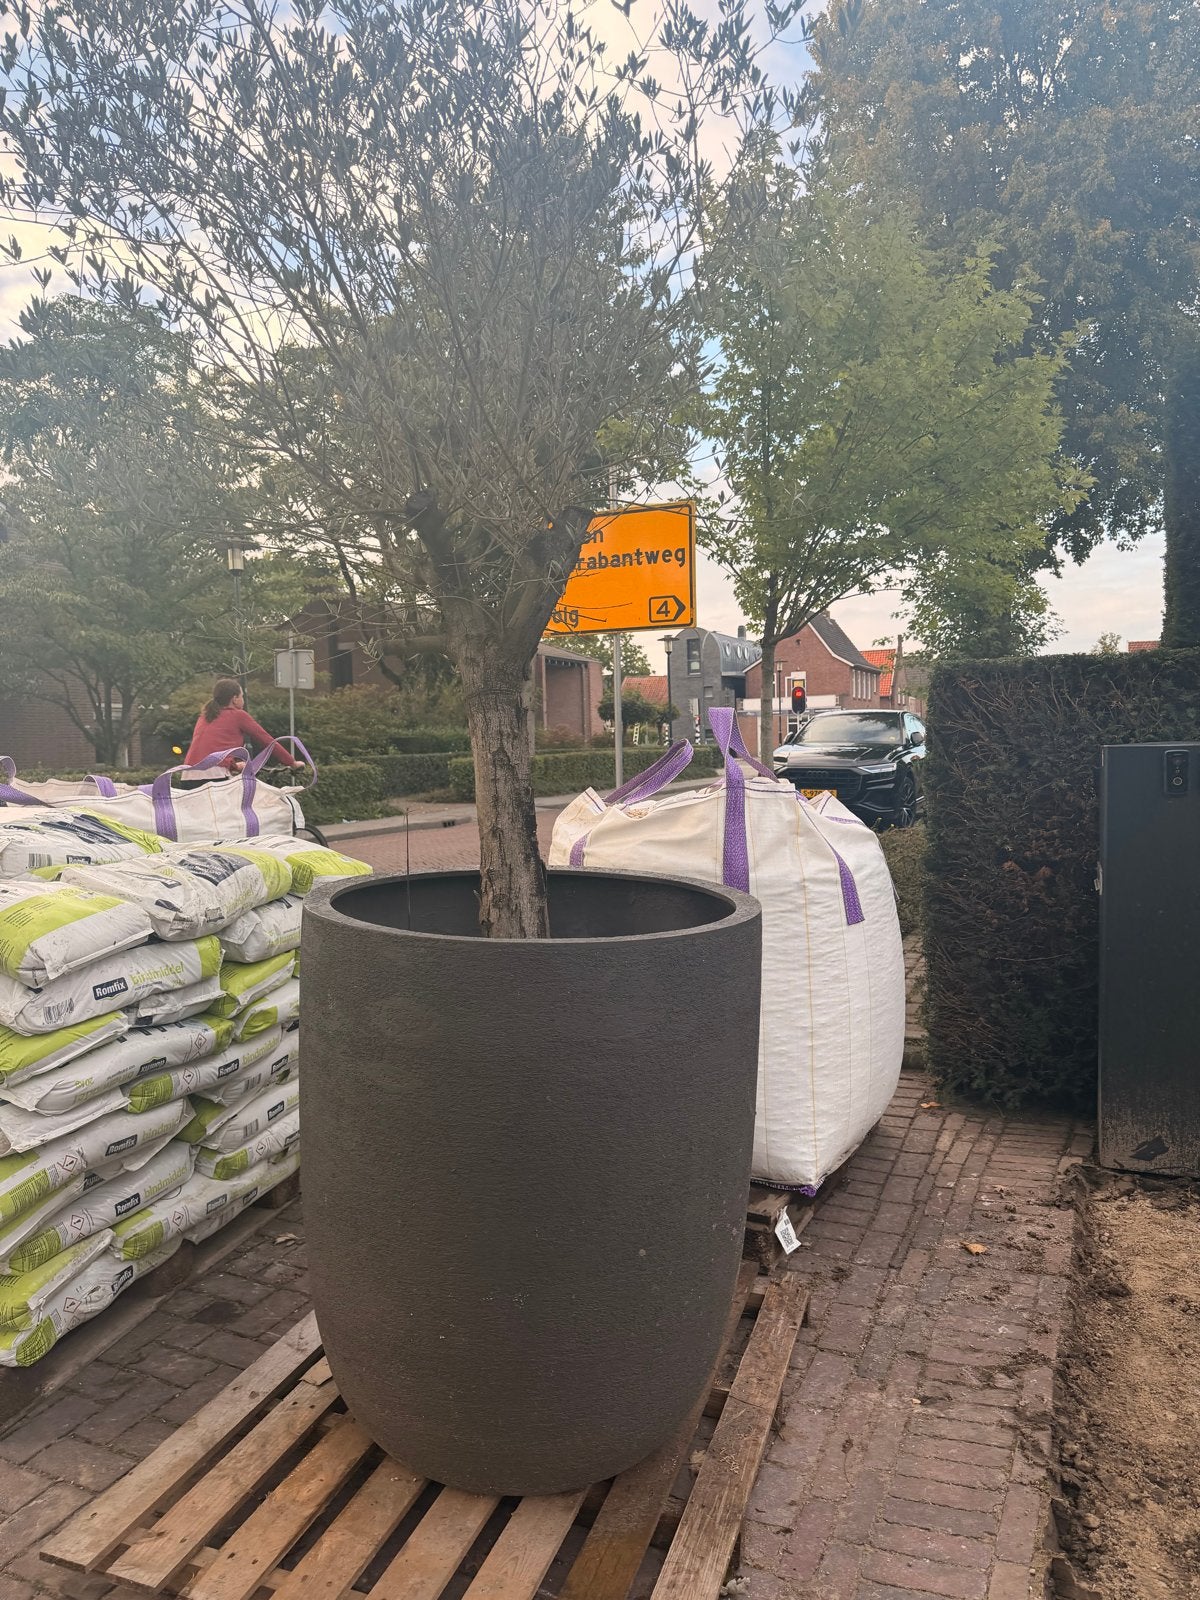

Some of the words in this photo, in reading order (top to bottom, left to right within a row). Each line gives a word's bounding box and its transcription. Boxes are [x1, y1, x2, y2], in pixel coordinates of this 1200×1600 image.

[577, 547, 686, 571] rabantweg
[655, 600, 671, 617] 4
[95, 981, 126, 998] Romfix
[130, 961, 184, 985] bindmiddel
[117, 1196, 140, 1215] Romfix
